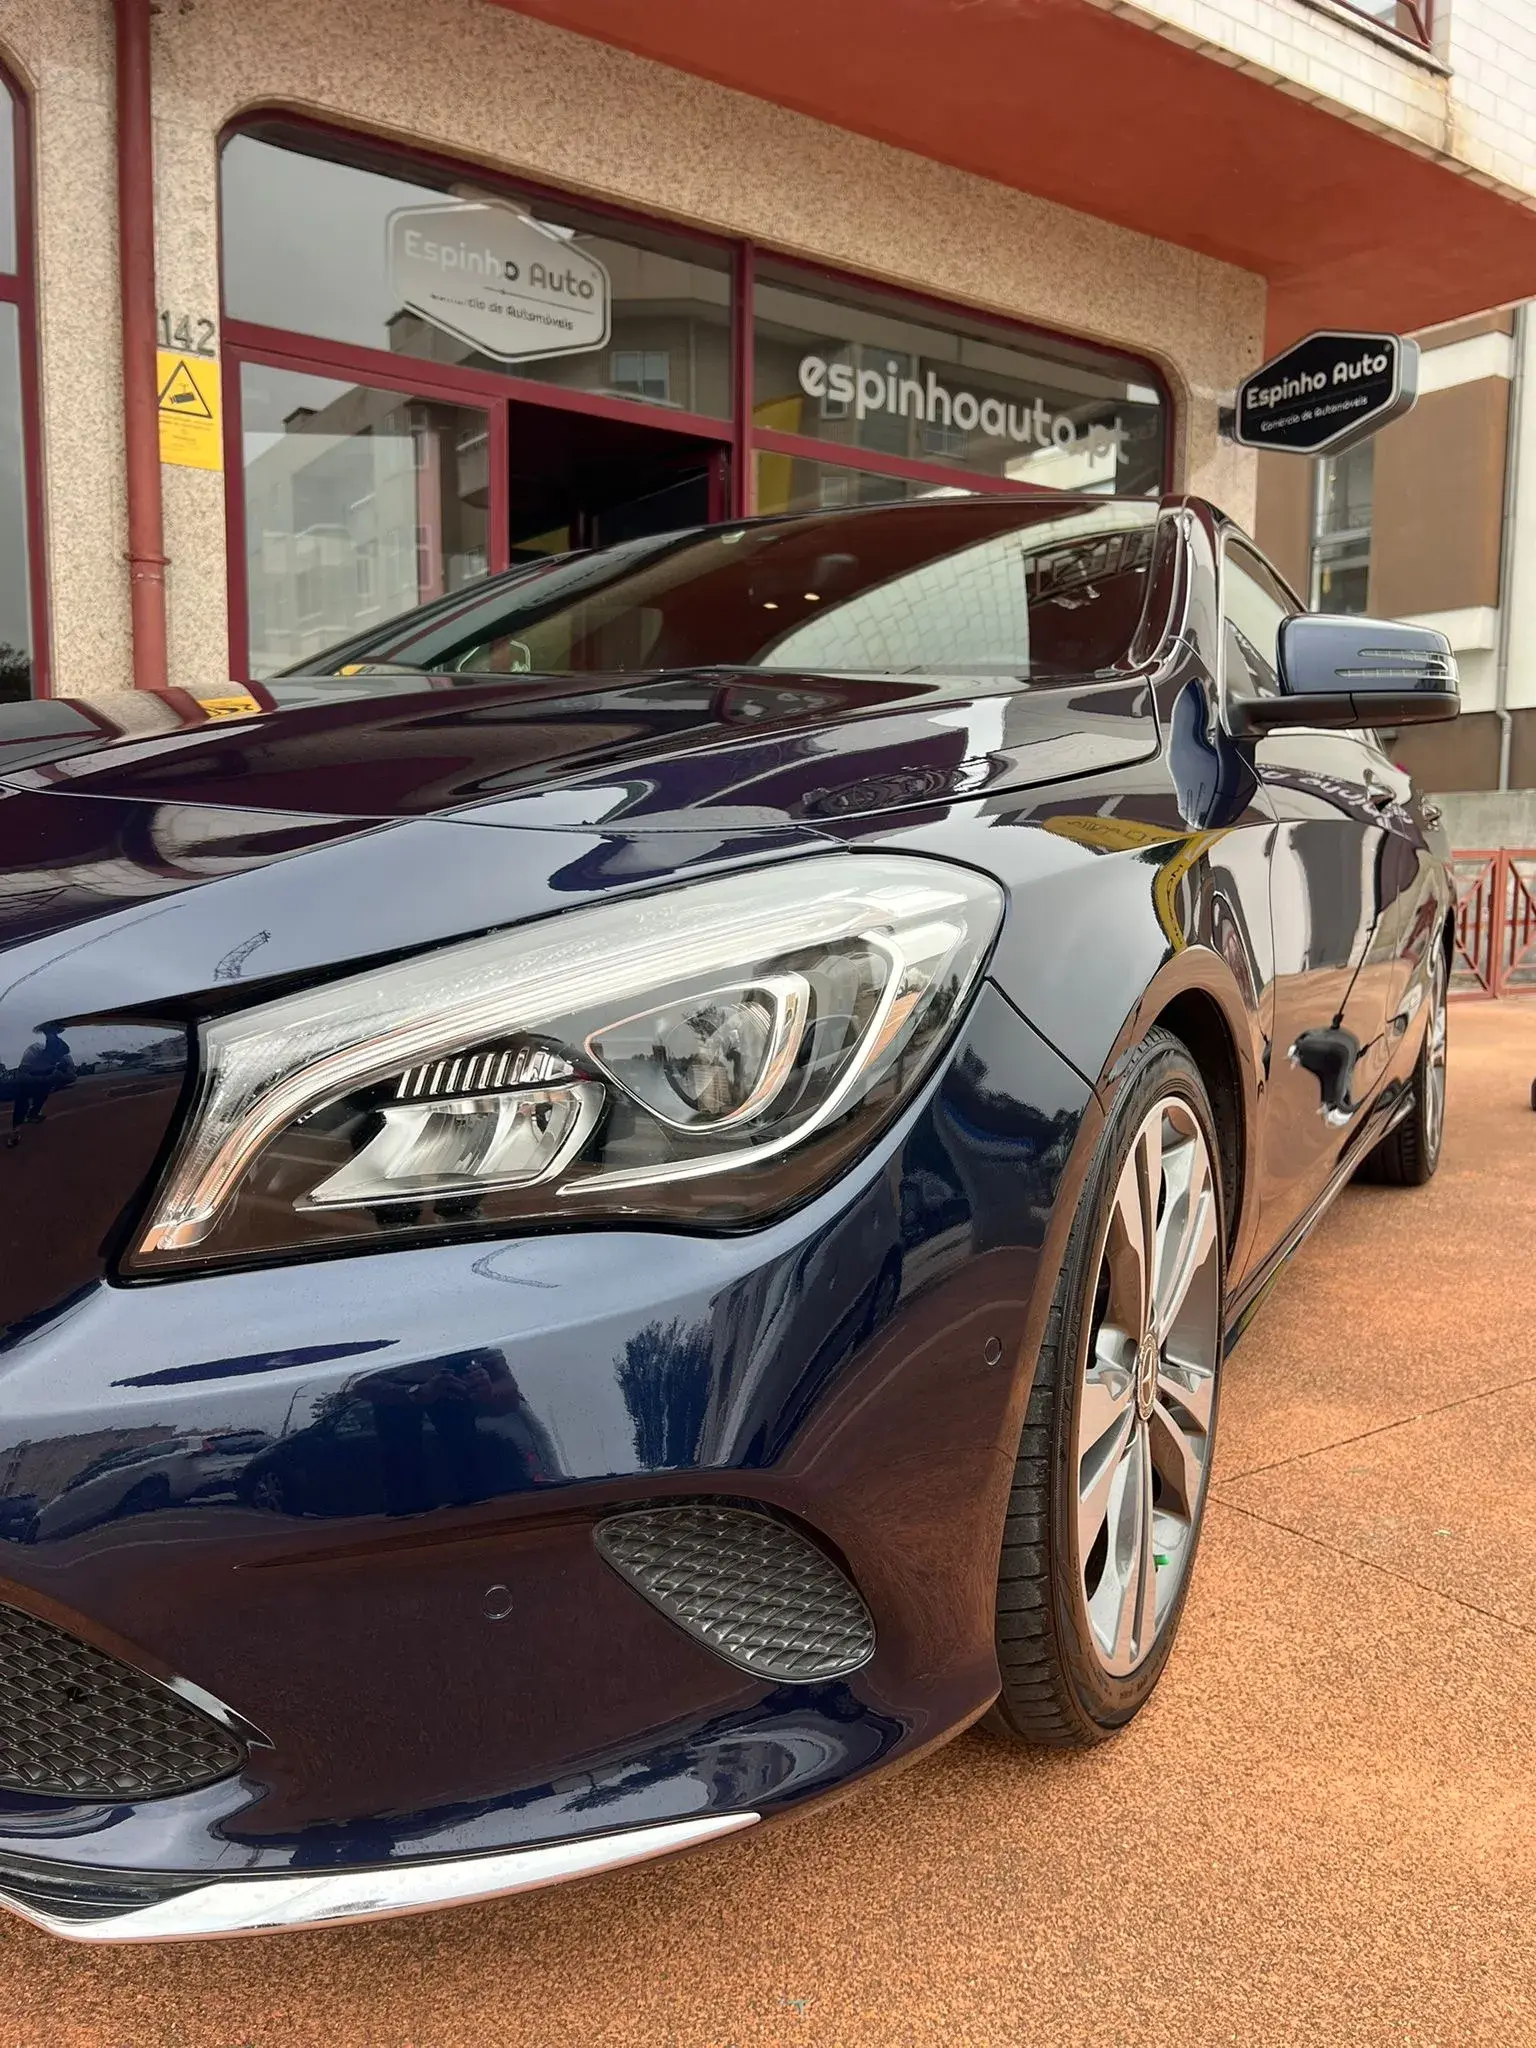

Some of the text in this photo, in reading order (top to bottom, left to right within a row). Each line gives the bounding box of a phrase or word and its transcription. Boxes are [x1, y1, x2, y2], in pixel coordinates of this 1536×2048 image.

[404, 229, 595, 300] Espinho Auto
[160, 310, 216, 357] 142
[1246, 353, 1388, 410] Espinho Auto
[1301, 407, 1313, 421] de
